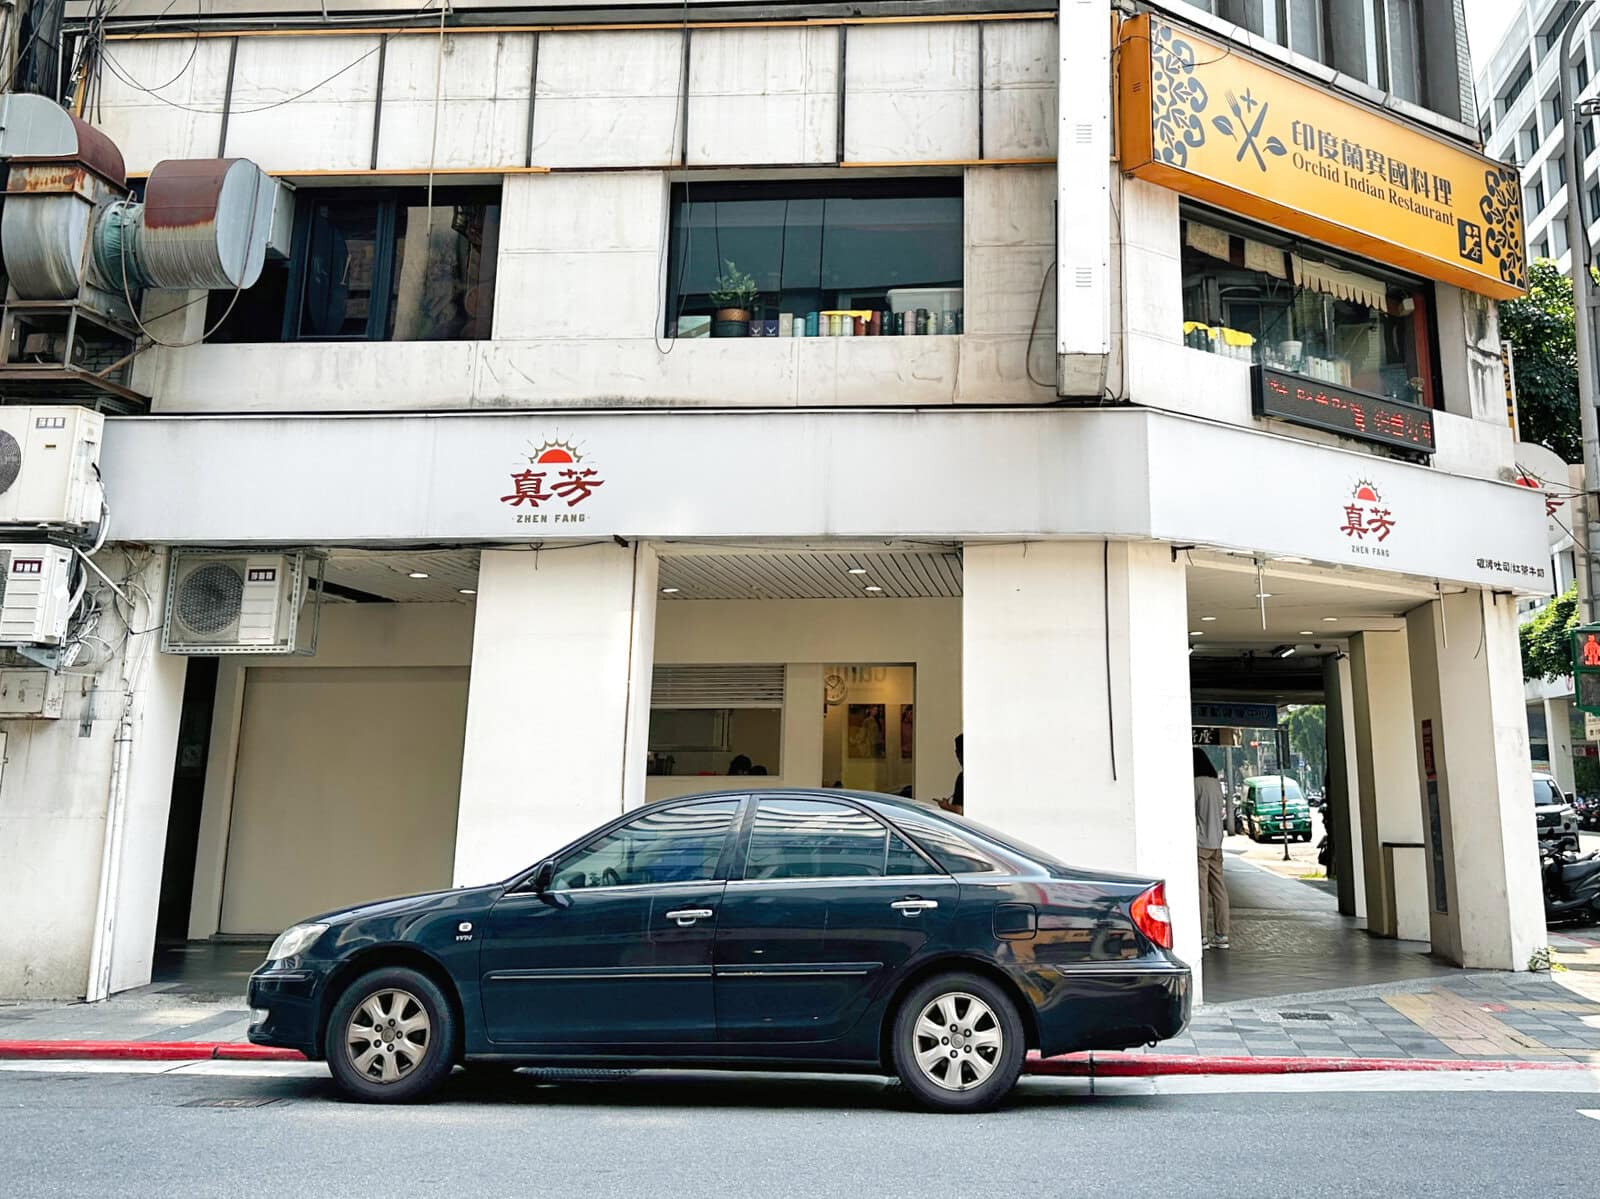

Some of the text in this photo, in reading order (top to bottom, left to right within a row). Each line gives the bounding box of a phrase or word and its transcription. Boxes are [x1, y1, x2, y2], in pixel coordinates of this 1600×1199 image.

[1291, 119, 1453, 208] 印度蘭異國料理
[1292, 152, 1455, 226] Orchid Indian Restaurant
[500, 468, 605, 507] 真芳
[516, 513, 586, 523] ZHEN FANG
[1340, 502, 1396, 542] 真芳
